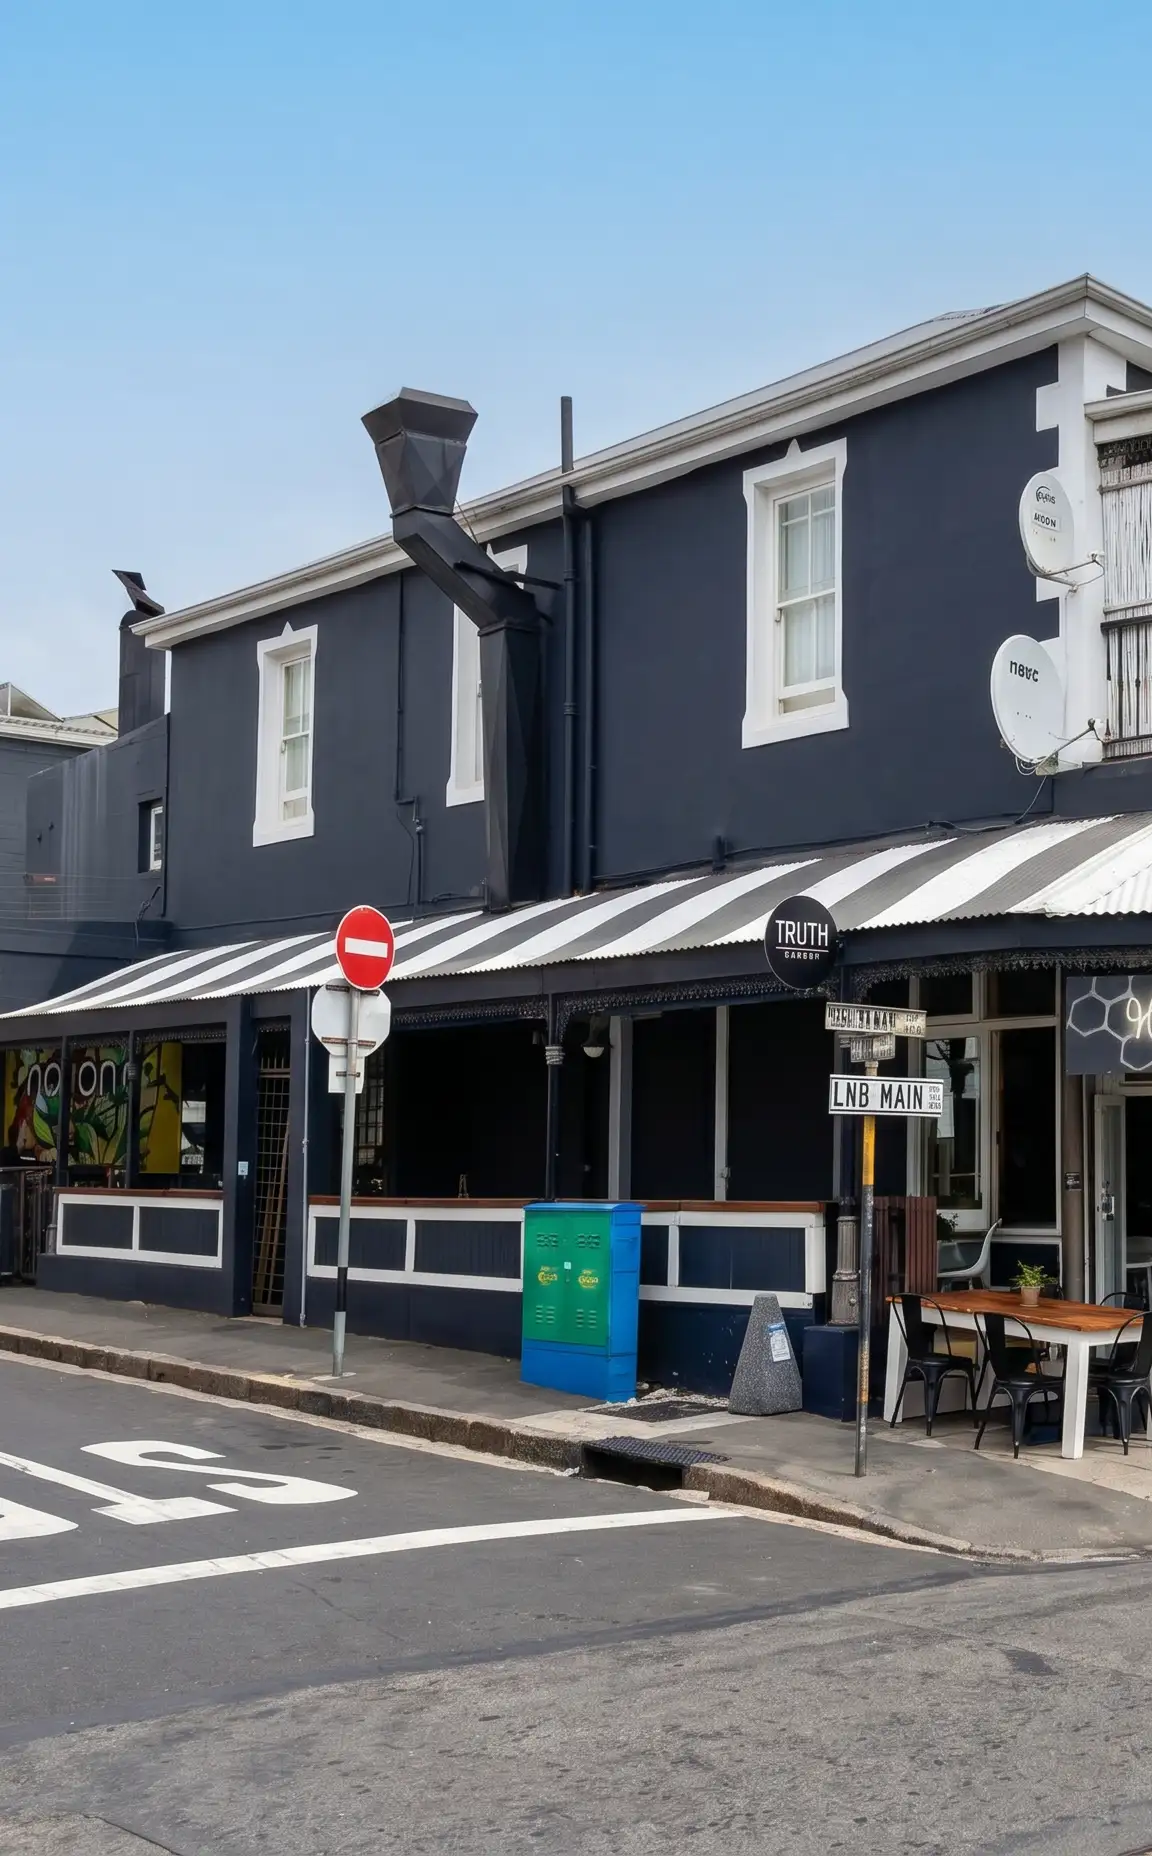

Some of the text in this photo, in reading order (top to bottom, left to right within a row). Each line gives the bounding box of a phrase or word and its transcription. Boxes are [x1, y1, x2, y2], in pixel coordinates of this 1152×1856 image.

[775, 919, 829, 947] TRUTH
[833, 1081, 870, 1108] LNB
[880, 1083, 923, 1110] MAIN
